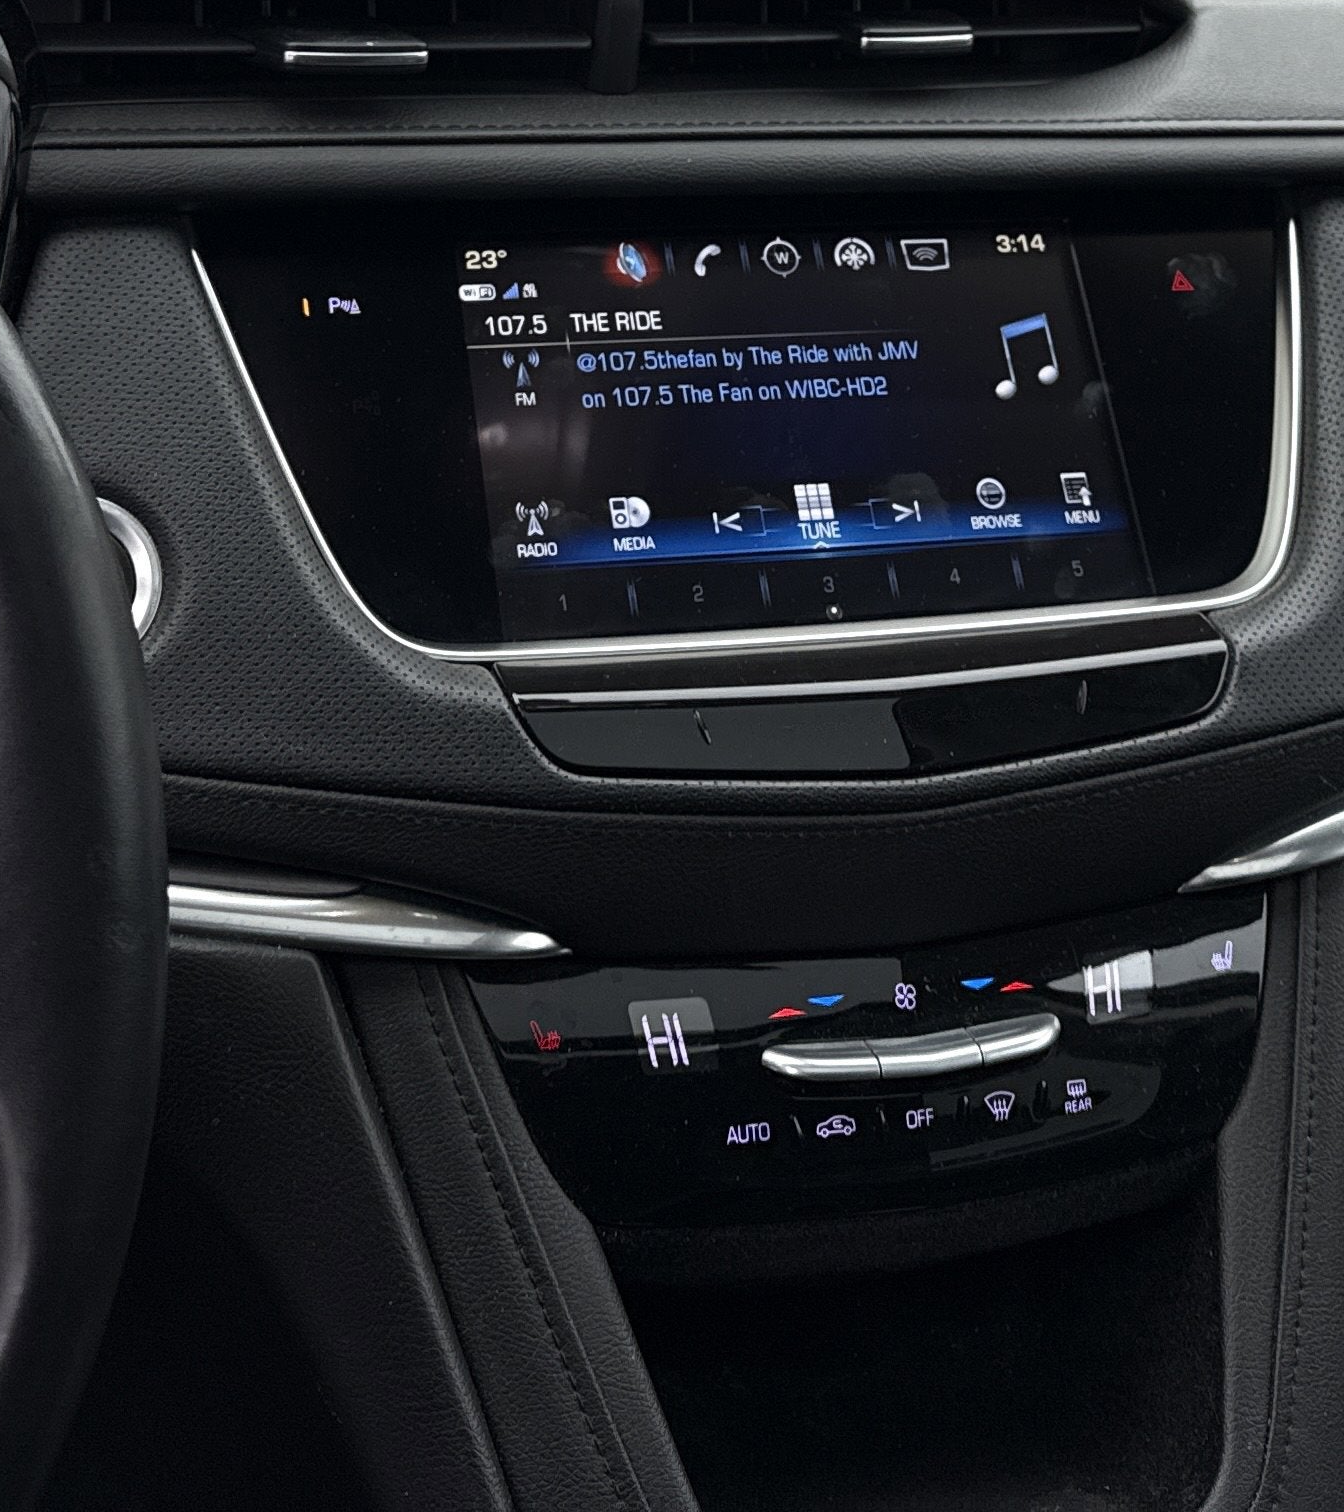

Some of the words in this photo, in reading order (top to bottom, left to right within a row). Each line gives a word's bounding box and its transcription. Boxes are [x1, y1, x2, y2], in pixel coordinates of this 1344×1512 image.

[996, 234, 1045, 253] 3:14
[484, 314, 548, 336] 107.5
[569, 313, 610, 333] THE
[615, 310, 663, 331] RIDE
[577, 349, 716, 372] @107.5thefan
[724, 348, 743, 370] by
[747, 344, 783, 366] The
[787, 342, 829, 365] Ride
[835, 340, 873, 361] with
[878, 340, 919, 361] JMV
[516, 392, 537, 406] FM
[582, 392, 606, 409] on
[612, 385, 674, 409] 107.5
[678, 384, 714, 405] The
[720, 383, 754, 403] Fan
[758, 383, 782, 400] on
[785, 376, 889, 399] WIBC-HD2
[970, 514, 1022, 531] BROWSE
[1064, 509, 1100, 524] MENU
[798, 520, 842, 540] TUNE
[517, 541, 558, 558] RADIO
[613, 536, 656, 551] MEDIA
[950, 568, 961, 585] 4
[1071, 560, 1084, 577] 5
[692, 584, 704, 603] 2
[823, 576, 835, 593] 3
[559, 594, 567, 612] 1
[641, 1012, 689, 1069] HI
[1064, 1096, 1093, 1114] REAR
[906, 1108, 935, 1130] OFF
[726, 1122, 771, 1145] AUTO
